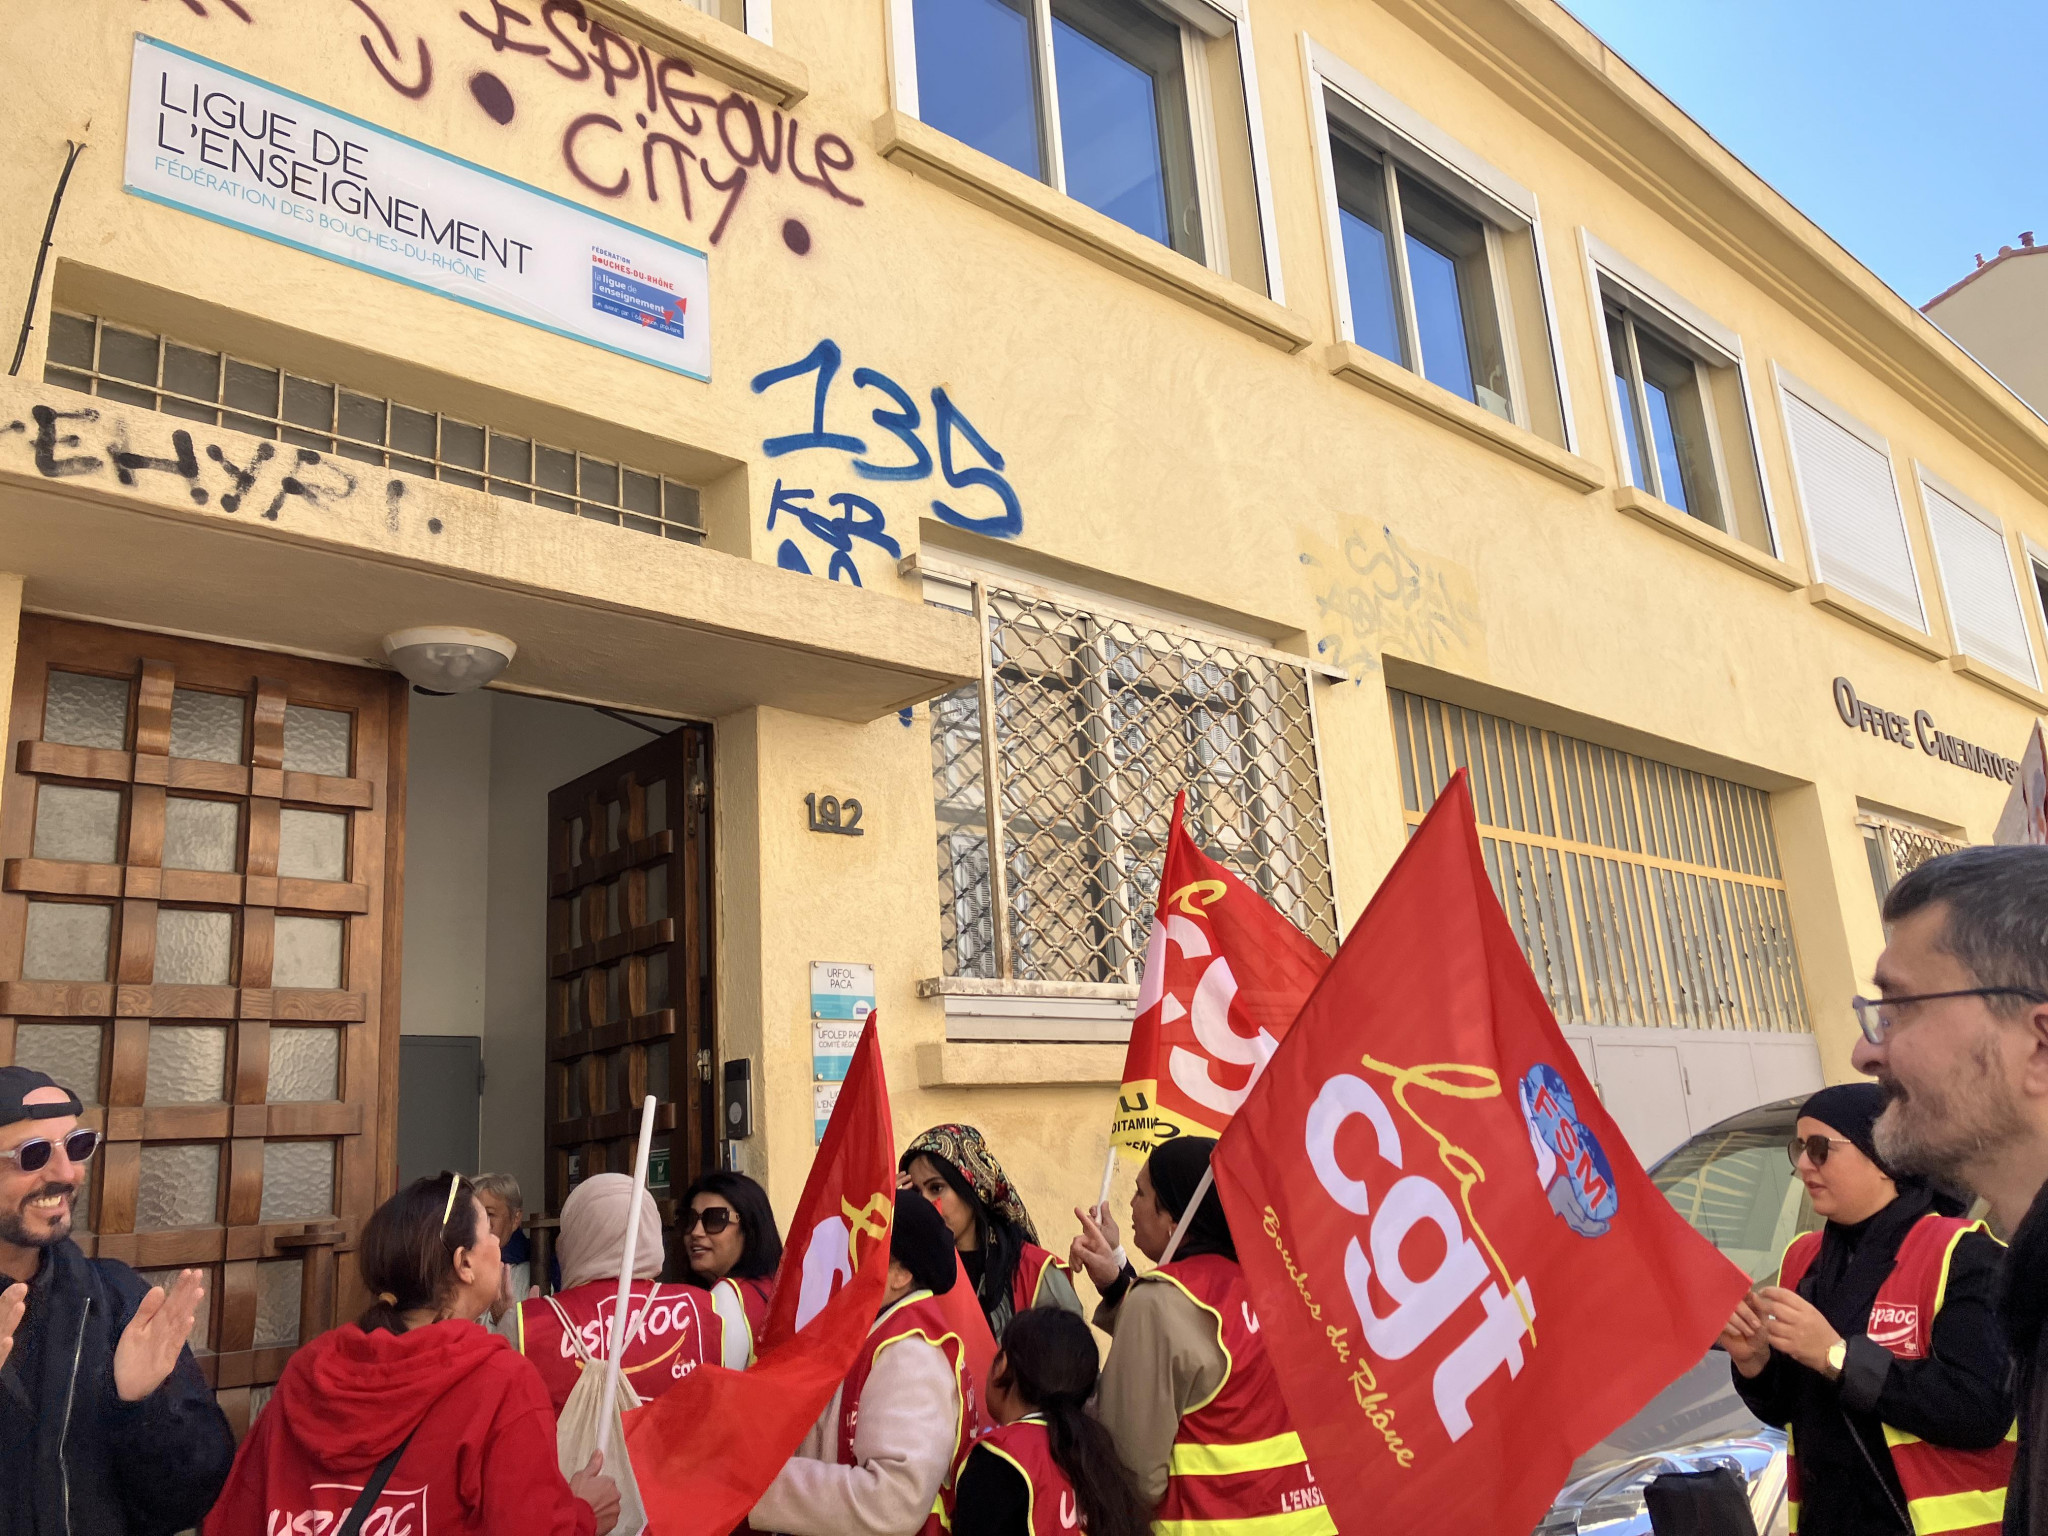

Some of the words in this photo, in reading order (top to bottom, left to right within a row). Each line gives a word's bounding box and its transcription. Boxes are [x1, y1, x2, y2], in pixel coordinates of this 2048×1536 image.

[160, 71, 297, 154] LIGUE
[312, 128, 369, 181] DE
[154, 156, 276, 211] FÉDÉRATION
[281, 200, 315, 223] DES
[319, 212, 487, 283] BOUCHES-DU-RHÔNE
[158, 112, 533, 275] L'ENSEIGNEMENT
[594, 281, 665, 314] l'enseignement
[602, 274, 627, 290] ligue
[627, 284, 637, 294] de
[751, 338, 1023, 539] 135
[804, 792, 865, 836] 192
[826, 968, 855, 979] URFOL
[830, 978, 853, 989] PACA
[818, 1030, 848, 1039] UFOLEP
[1533, 1084, 1608, 1212] FSM
[1306, 1073, 1537, 1443] cgt
[1262, 1205, 1322, 1321] Bouches
[1326, 1325, 1350, 1363] du
[1348, 1357, 1415, 1468] Rhône
